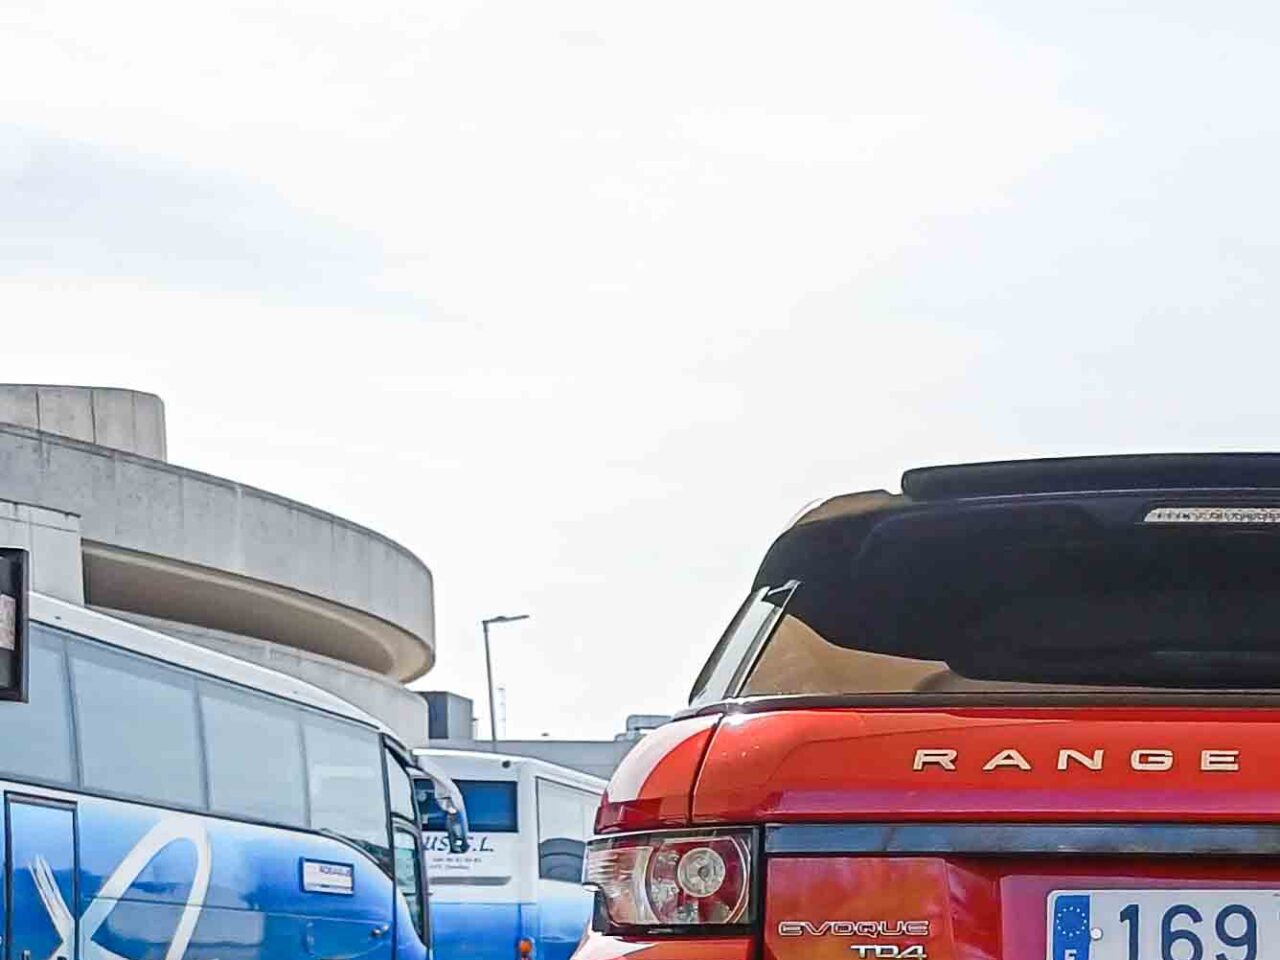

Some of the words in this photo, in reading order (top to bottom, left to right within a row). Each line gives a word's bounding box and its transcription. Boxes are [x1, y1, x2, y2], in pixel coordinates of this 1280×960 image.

[911, 749, 1240, 771] RANGE
[778, 920, 930, 939] EVOQUE
[850, 945, 928, 960] TD4
